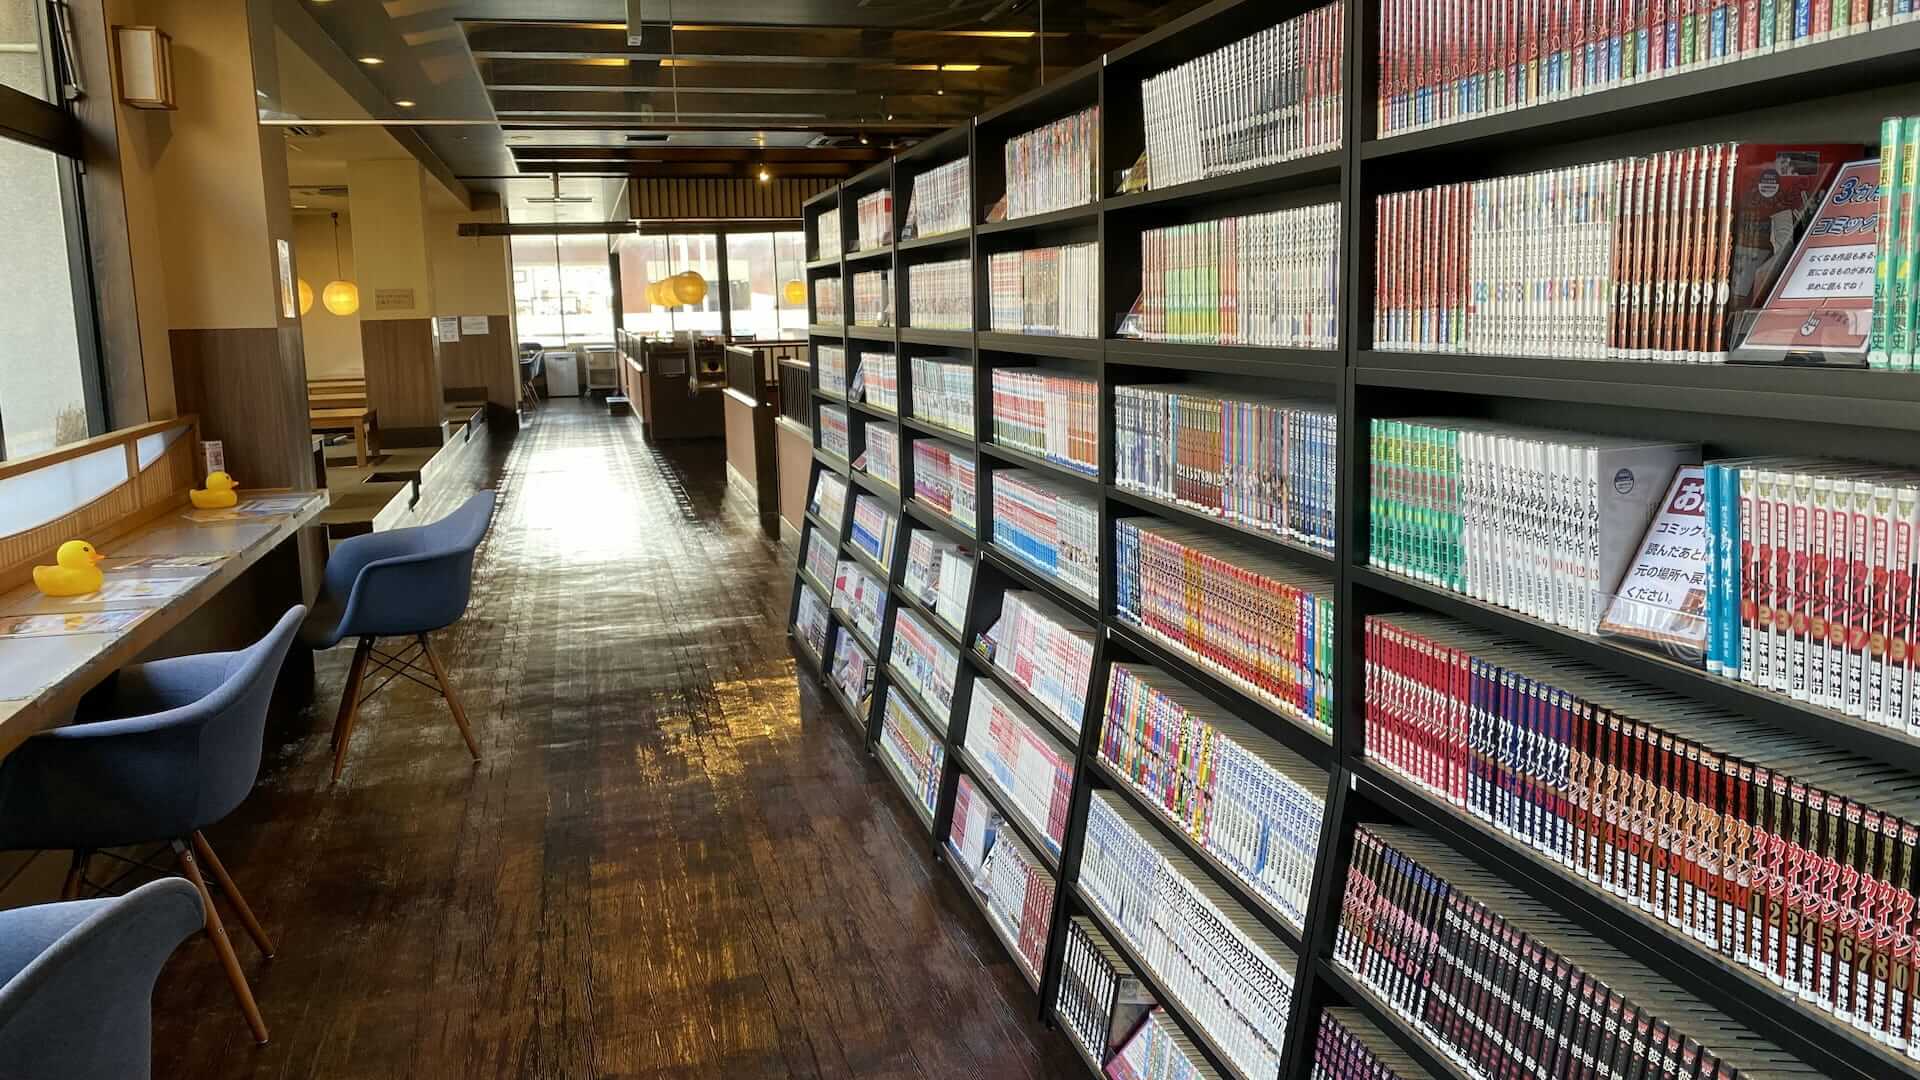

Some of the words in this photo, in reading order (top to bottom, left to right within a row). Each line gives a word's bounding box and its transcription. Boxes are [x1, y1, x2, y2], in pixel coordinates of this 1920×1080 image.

[1627, 586, 1673, 605] ください。
[1752, 825, 1769, 888] カイジ
[1769, 833, 1787, 897] カイジ
[1787, 841, 1804, 906] カイジ
[1803, 850, 1822, 914] カイジ
[1821, 857, 1840, 922] カイジ
[1840, 864, 1859, 931] カイジ
[1753, 894, 1761, 916] 1
[1770, 902, 1780, 927] 2
[1858, 873, 1879, 940] カイジ
[1876, 880, 1897, 947] カイジ
[1788, 911, 1799, 936] 3
[1804, 921, 1816, 944] 4
[1895, 888, 1916, 957] カイジ
[1821, 927, 1834, 952] 5
[1840, 938, 1852, 961] 6
[1858, 948, 1871, 970] 7
[1876, 954, 1888, 980] 8
[1893, 963, 1908, 990] 10
